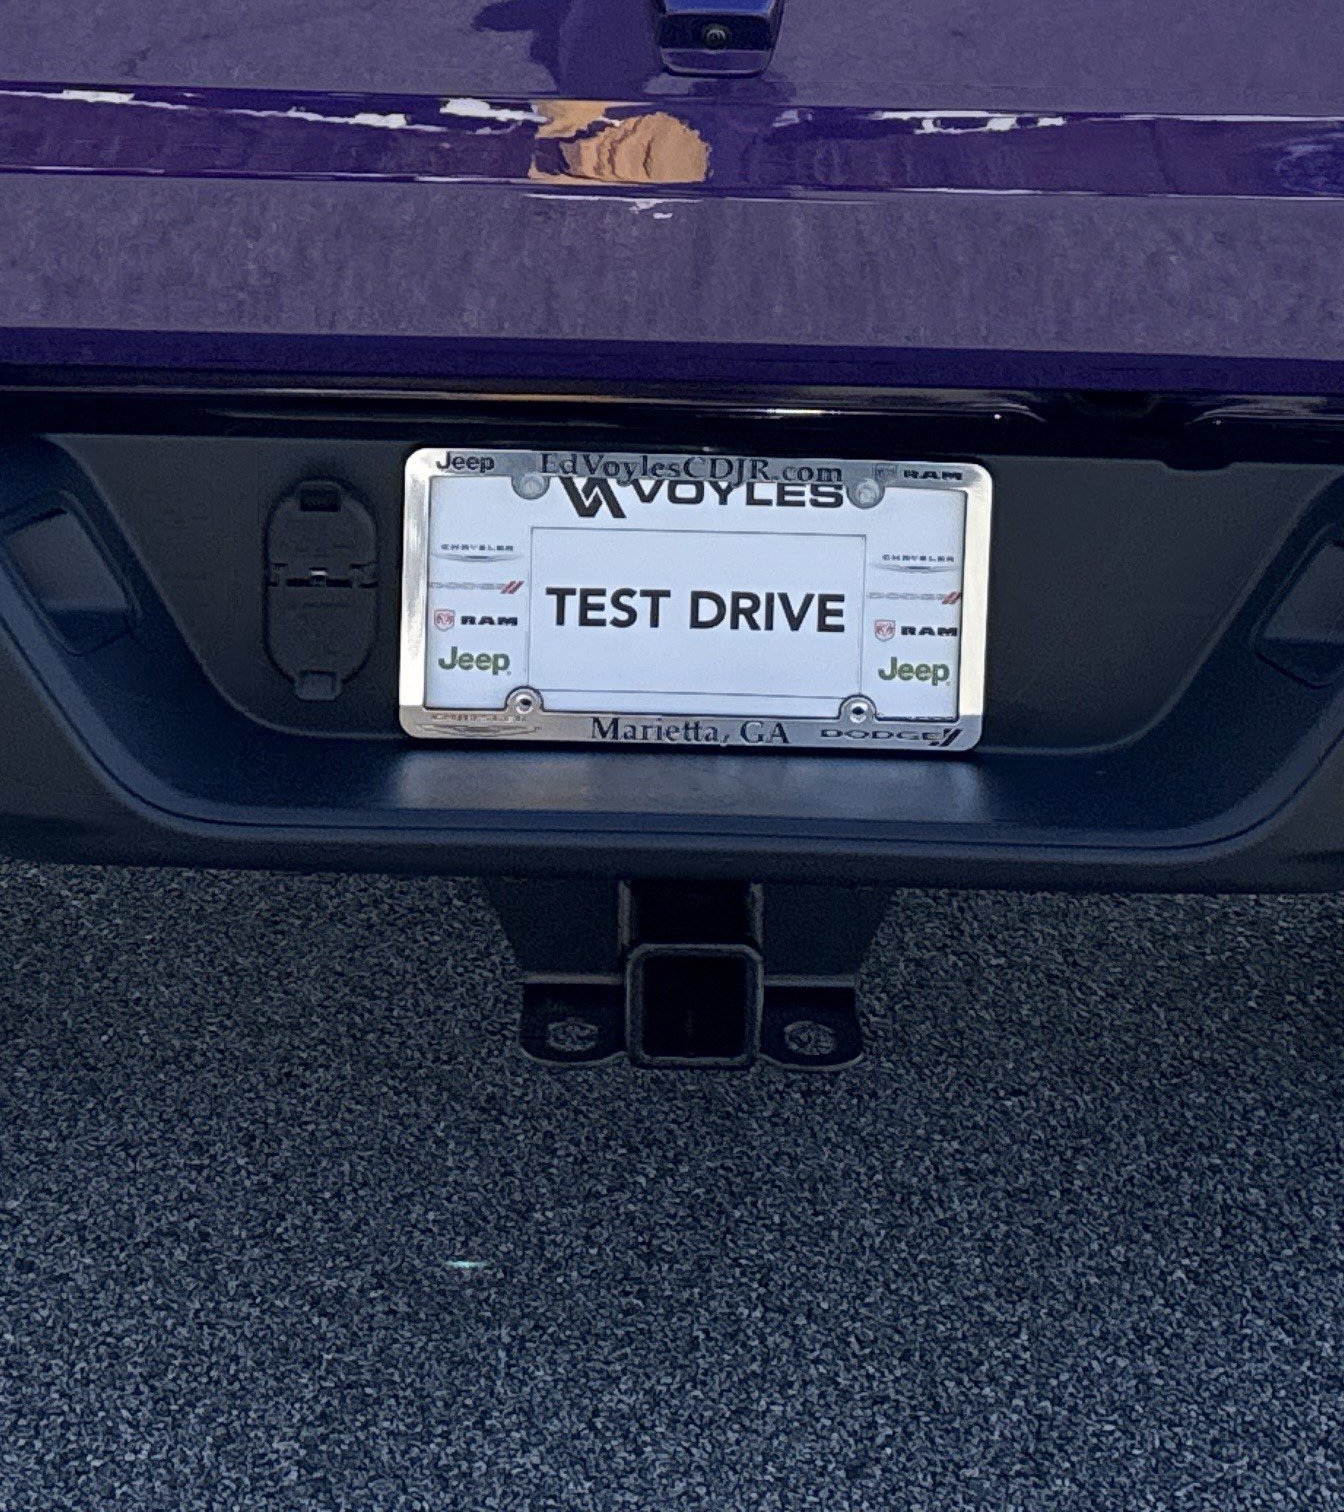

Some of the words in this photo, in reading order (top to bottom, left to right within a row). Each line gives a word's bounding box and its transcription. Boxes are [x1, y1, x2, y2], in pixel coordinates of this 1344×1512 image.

[436, 451, 495, 473] Jeep
[540, 452, 843, 488] EdVoylesCDJR.com
[903, 469, 963, 480] RAM
[632, 478, 844, 509] VOYLES
[460, 615, 518, 626] RAM
[545, 586, 671, 628] TEST
[689, 590, 845, 632] DRIVE
[900, 625, 958, 637] RAM
[438, 646, 511, 676] Jeep
[878, 656, 950, 686] Jeep
[590, 716, 730, 745] Marietta,
[740, 720, 790, 745] GA
[820, 728, 942, 741] DODGE
